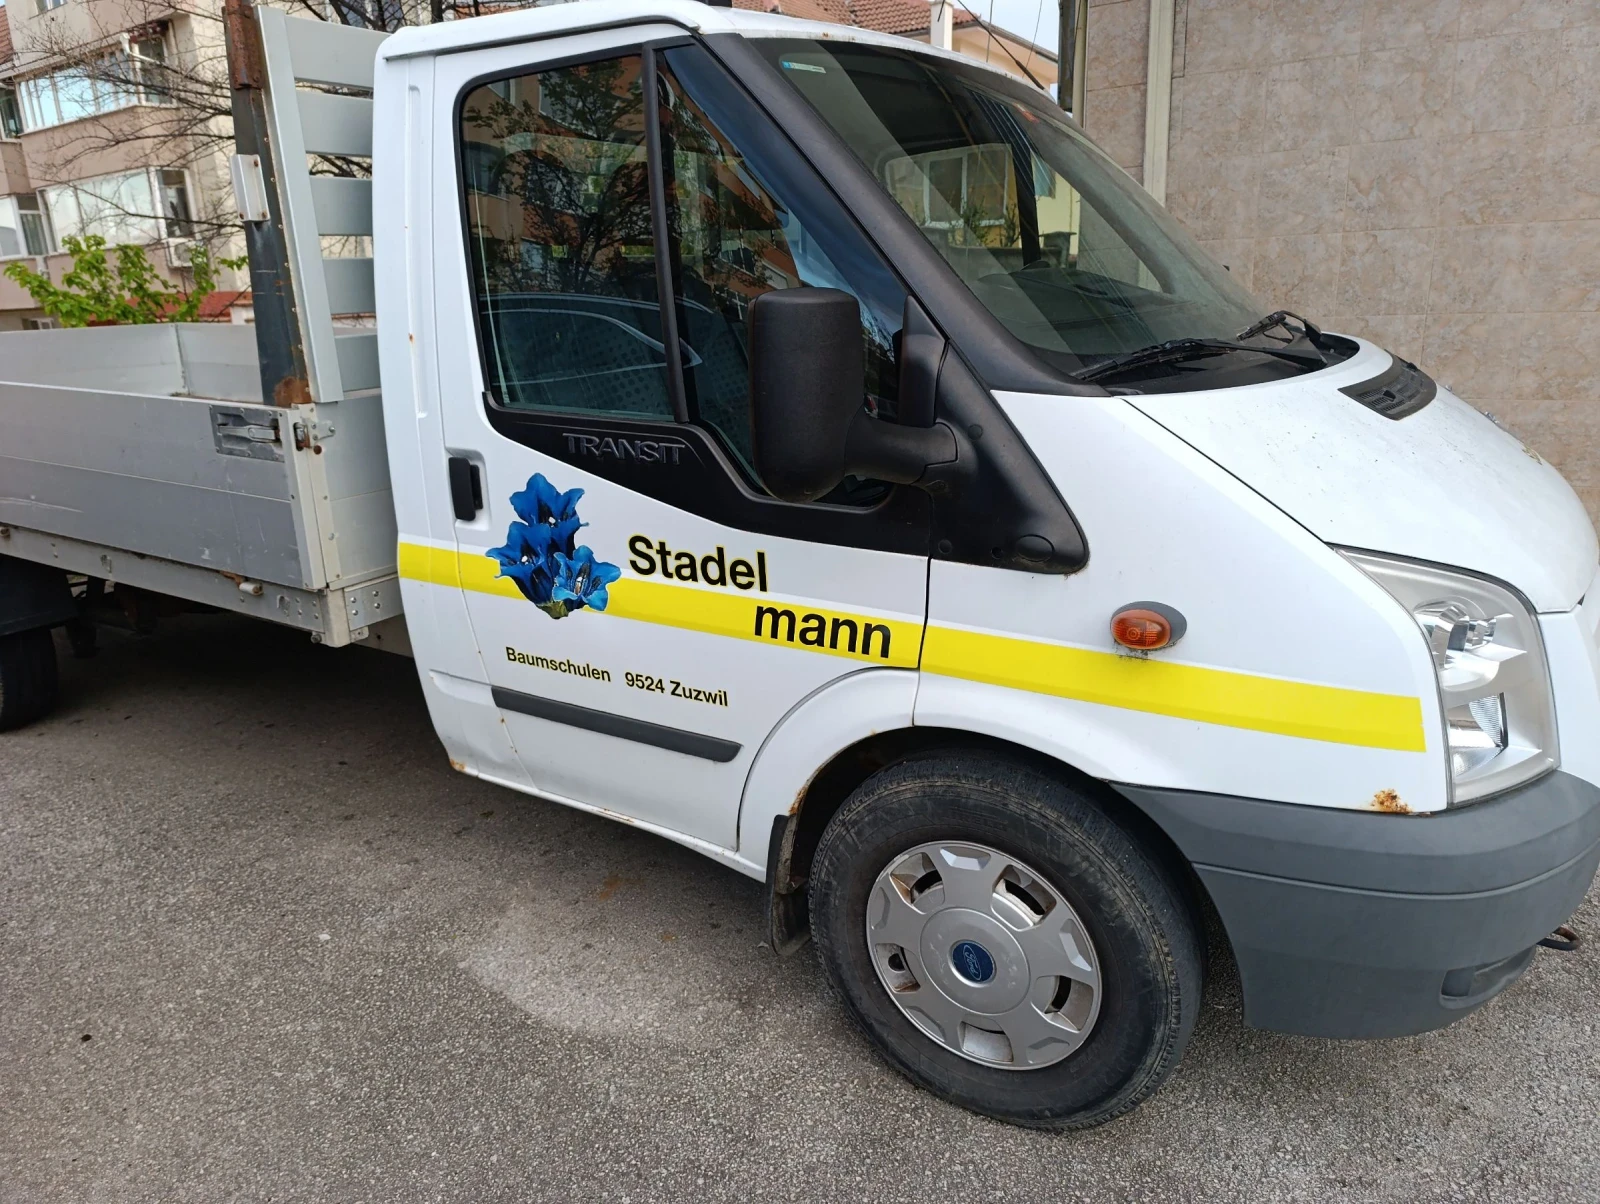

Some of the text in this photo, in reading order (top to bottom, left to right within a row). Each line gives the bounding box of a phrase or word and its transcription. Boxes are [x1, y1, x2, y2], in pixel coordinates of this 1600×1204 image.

[562, 432, 686, 465] TRANSIT
[628, 534, 768, 593] Stadel
[754, 605, 891, 659] mann
[505, 645, 728, 707] Baumschulen 9524 Zuzwil
